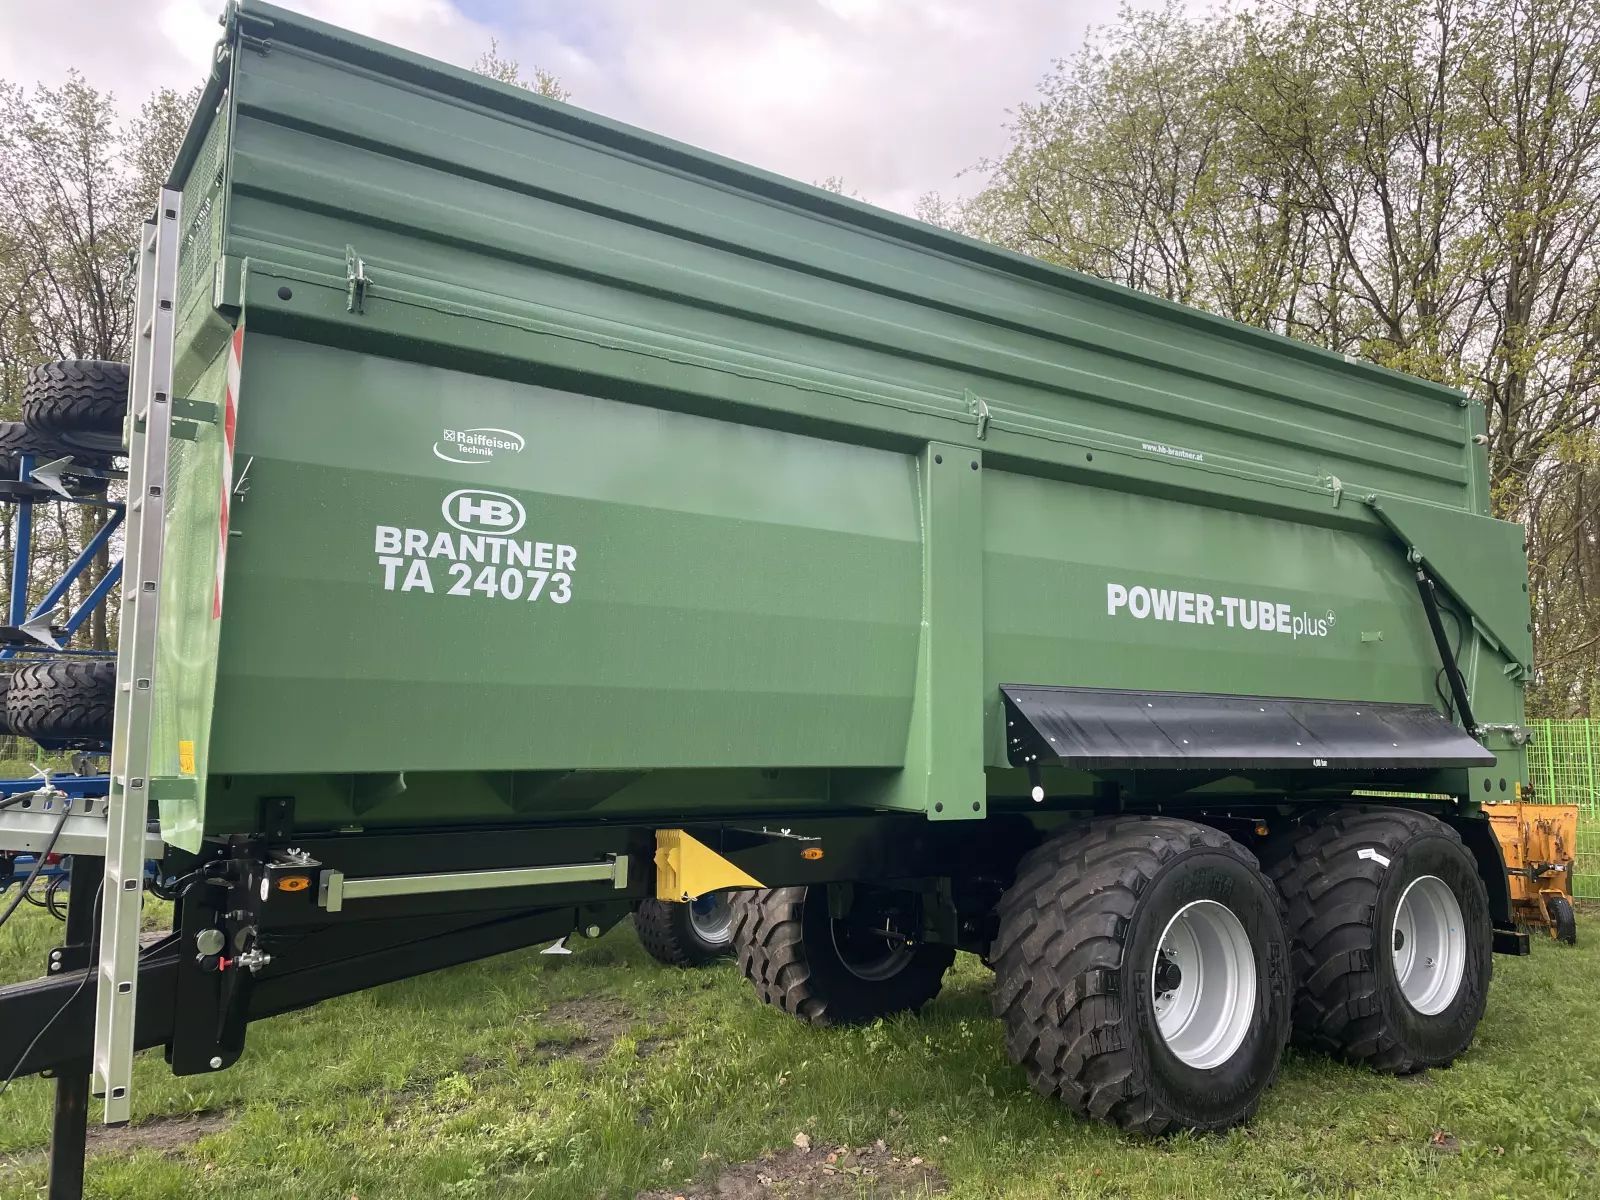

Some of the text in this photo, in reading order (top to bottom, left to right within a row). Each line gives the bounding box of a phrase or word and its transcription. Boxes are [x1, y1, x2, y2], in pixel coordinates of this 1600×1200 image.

[457, 431, 519, 451] Raiffeisen
[457, 443, 494, 457] Technik
[458, 496, 514, 527] HB
[374, 525, 577, 572] BRANTNER
[378, 556, 572, 604] TA 24073
